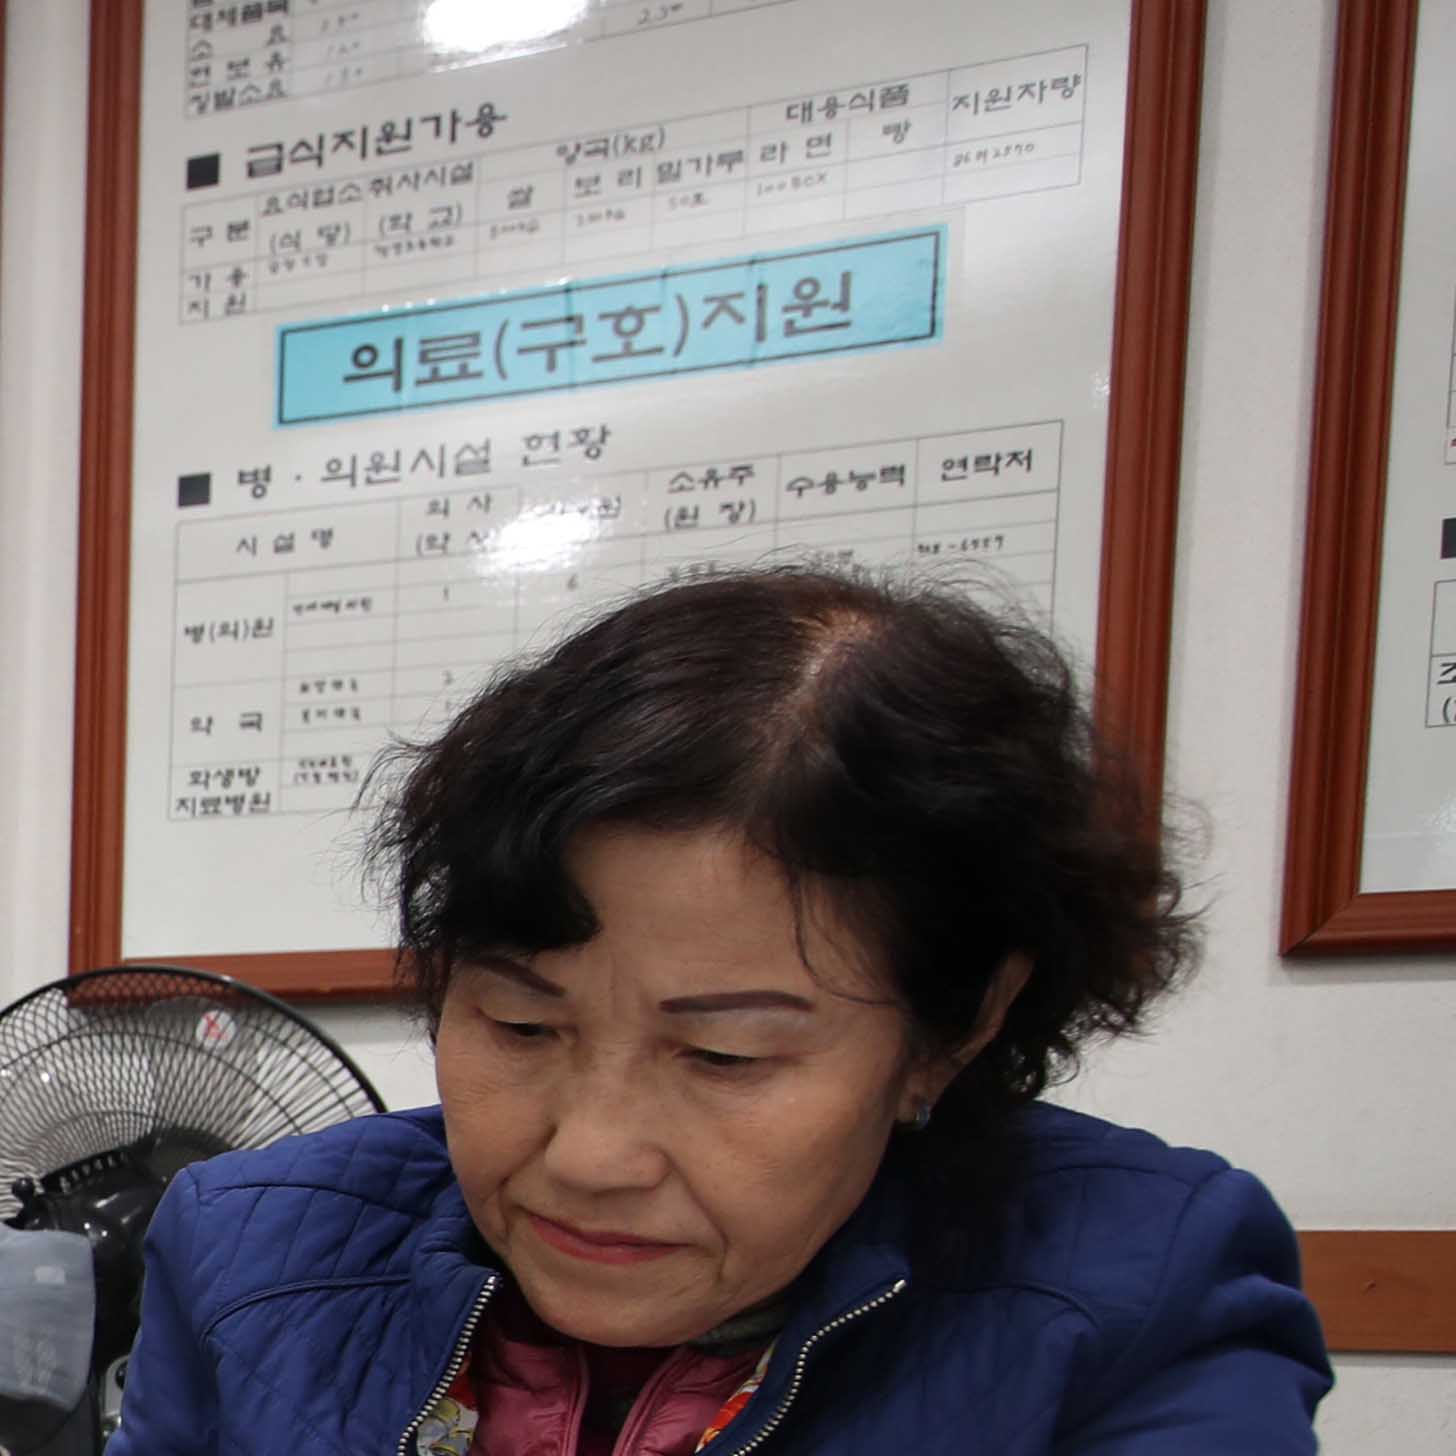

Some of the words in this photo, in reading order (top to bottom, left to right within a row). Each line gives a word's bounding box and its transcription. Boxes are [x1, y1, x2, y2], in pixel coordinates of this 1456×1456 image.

[245, 101, 508, 179] 급식지원가용
[784, 83, 911, 125] 대용식품
[341, 270, 856, 394] 의료(구호)지원
[237, 464, 272, 500] 병
[320, 437, 493, 488] 의원시설
[521, 423, 612, 468] 현황
[665, 463, 756, 495] 소유주
[785, 463, 907, 499] 수용능력
